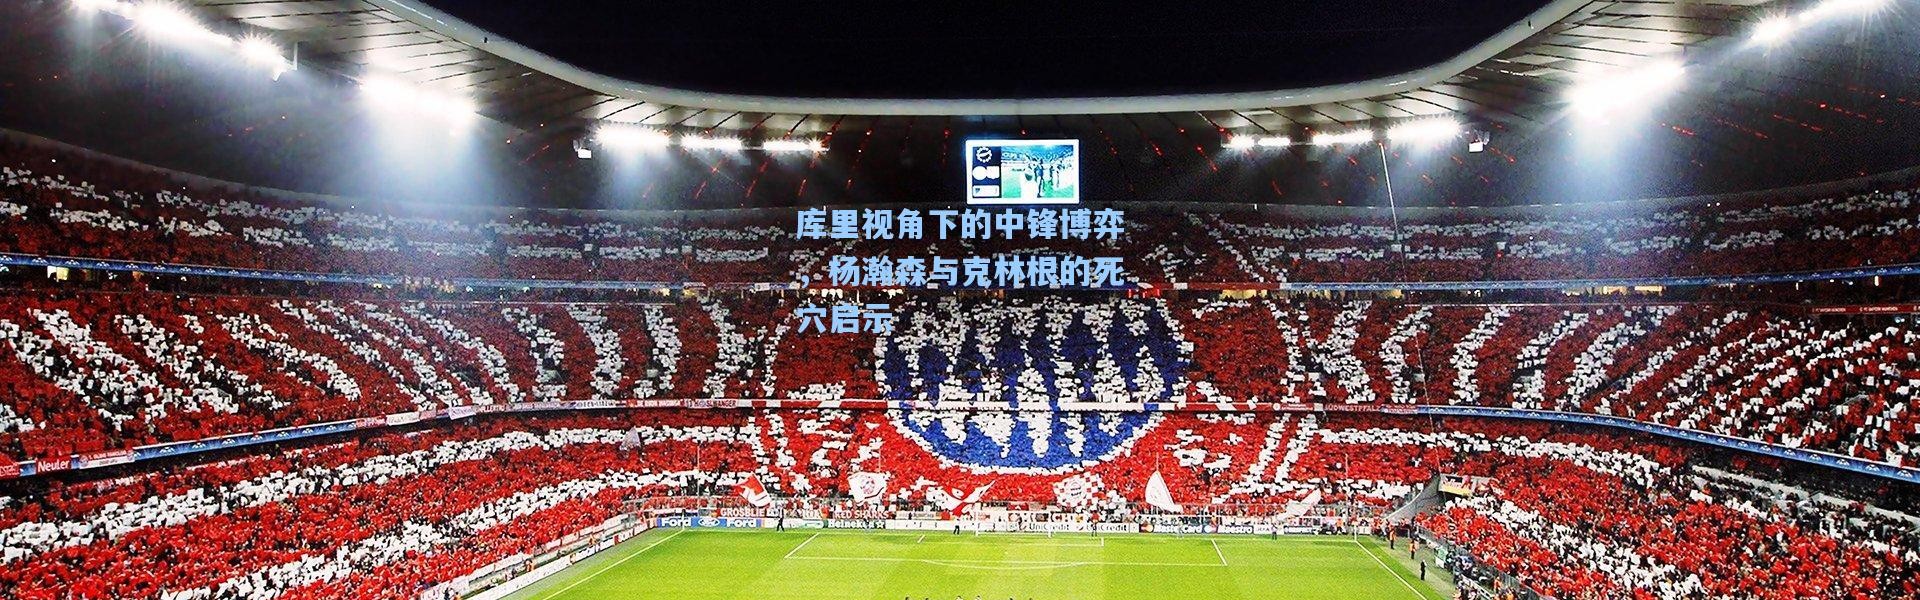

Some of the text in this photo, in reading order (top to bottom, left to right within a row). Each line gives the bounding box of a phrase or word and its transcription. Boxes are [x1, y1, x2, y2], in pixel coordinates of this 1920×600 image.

[37, 459, 70, 473] Neuler
[835, 510, 852, 519] RED
[854, 510, 889, 519] SHARKS
[661, 517, 692, 527] Ford
[726, 518, 757, 527] Ford
